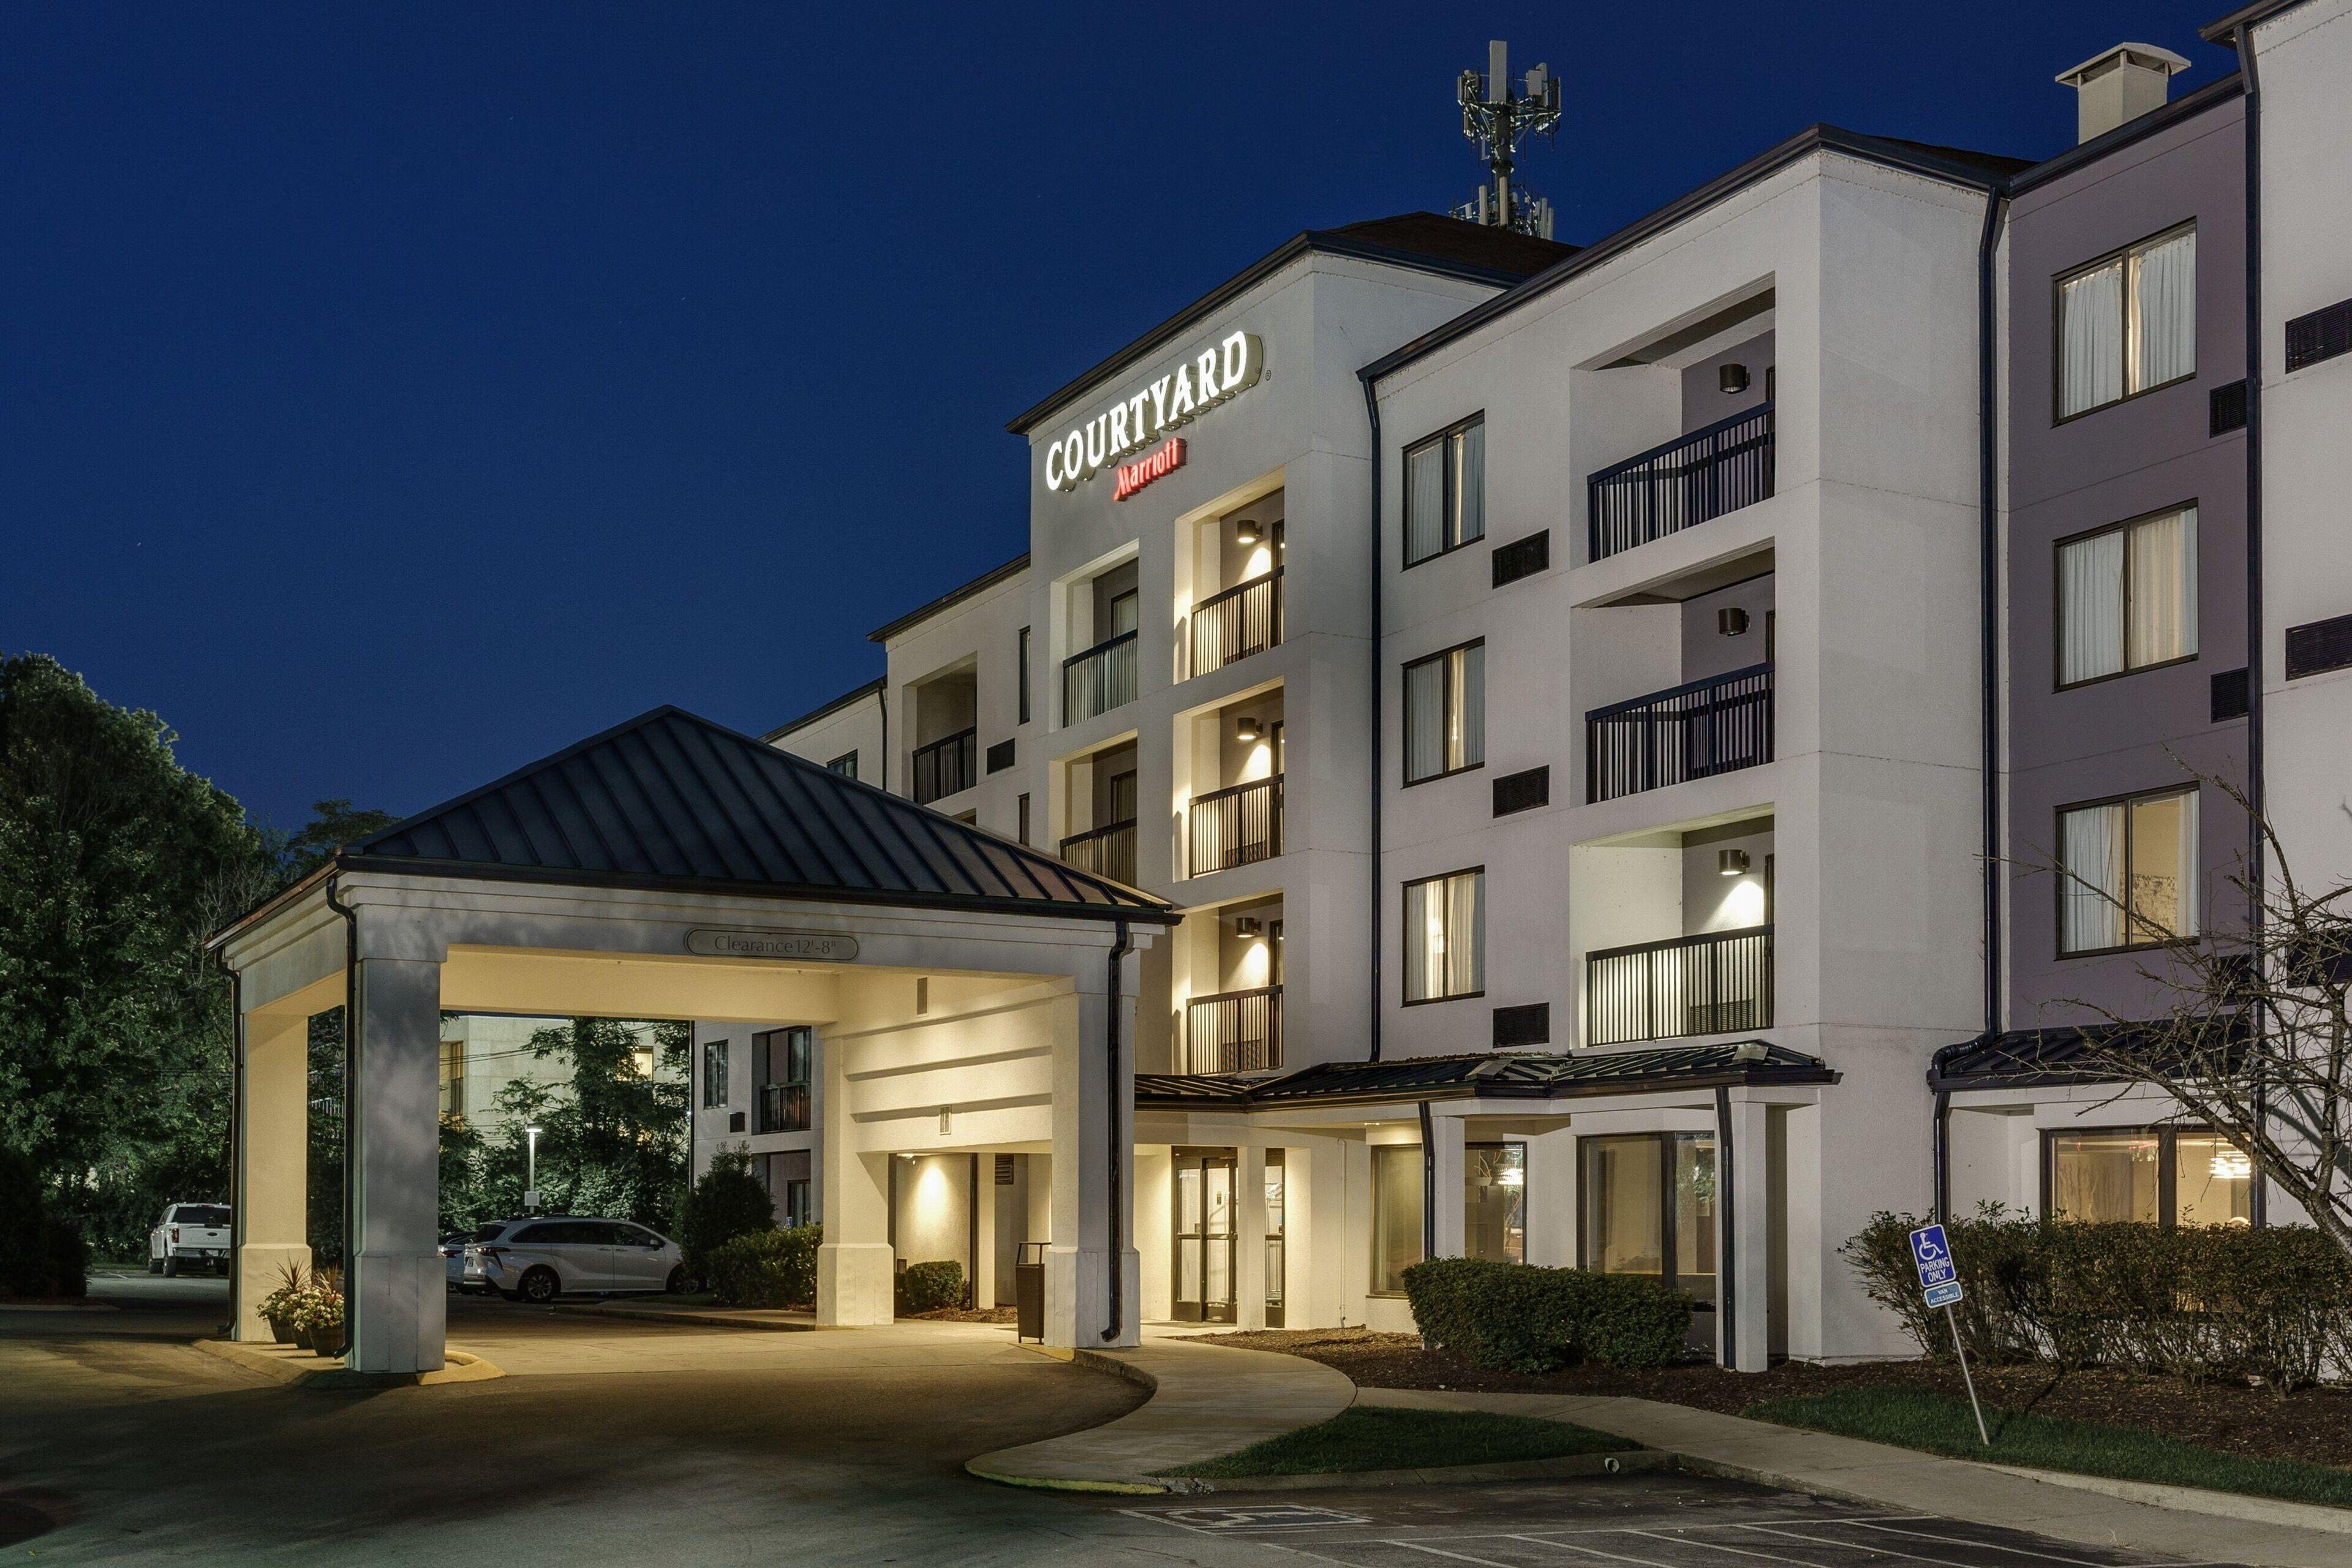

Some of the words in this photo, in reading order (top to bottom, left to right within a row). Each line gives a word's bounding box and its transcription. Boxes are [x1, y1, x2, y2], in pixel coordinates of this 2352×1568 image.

[1046, 331, 1248, 491] COURTYARD
[1113, 437, 1180, 501] Marriott
[714, 936, 793, 953] Clearance
[1920, 1257, 1950, 1273] PARKING
[1928, 1268, 1947, 1283] ONLY
[1931, 1291, 1959, 1304] ACCESSIBLE
